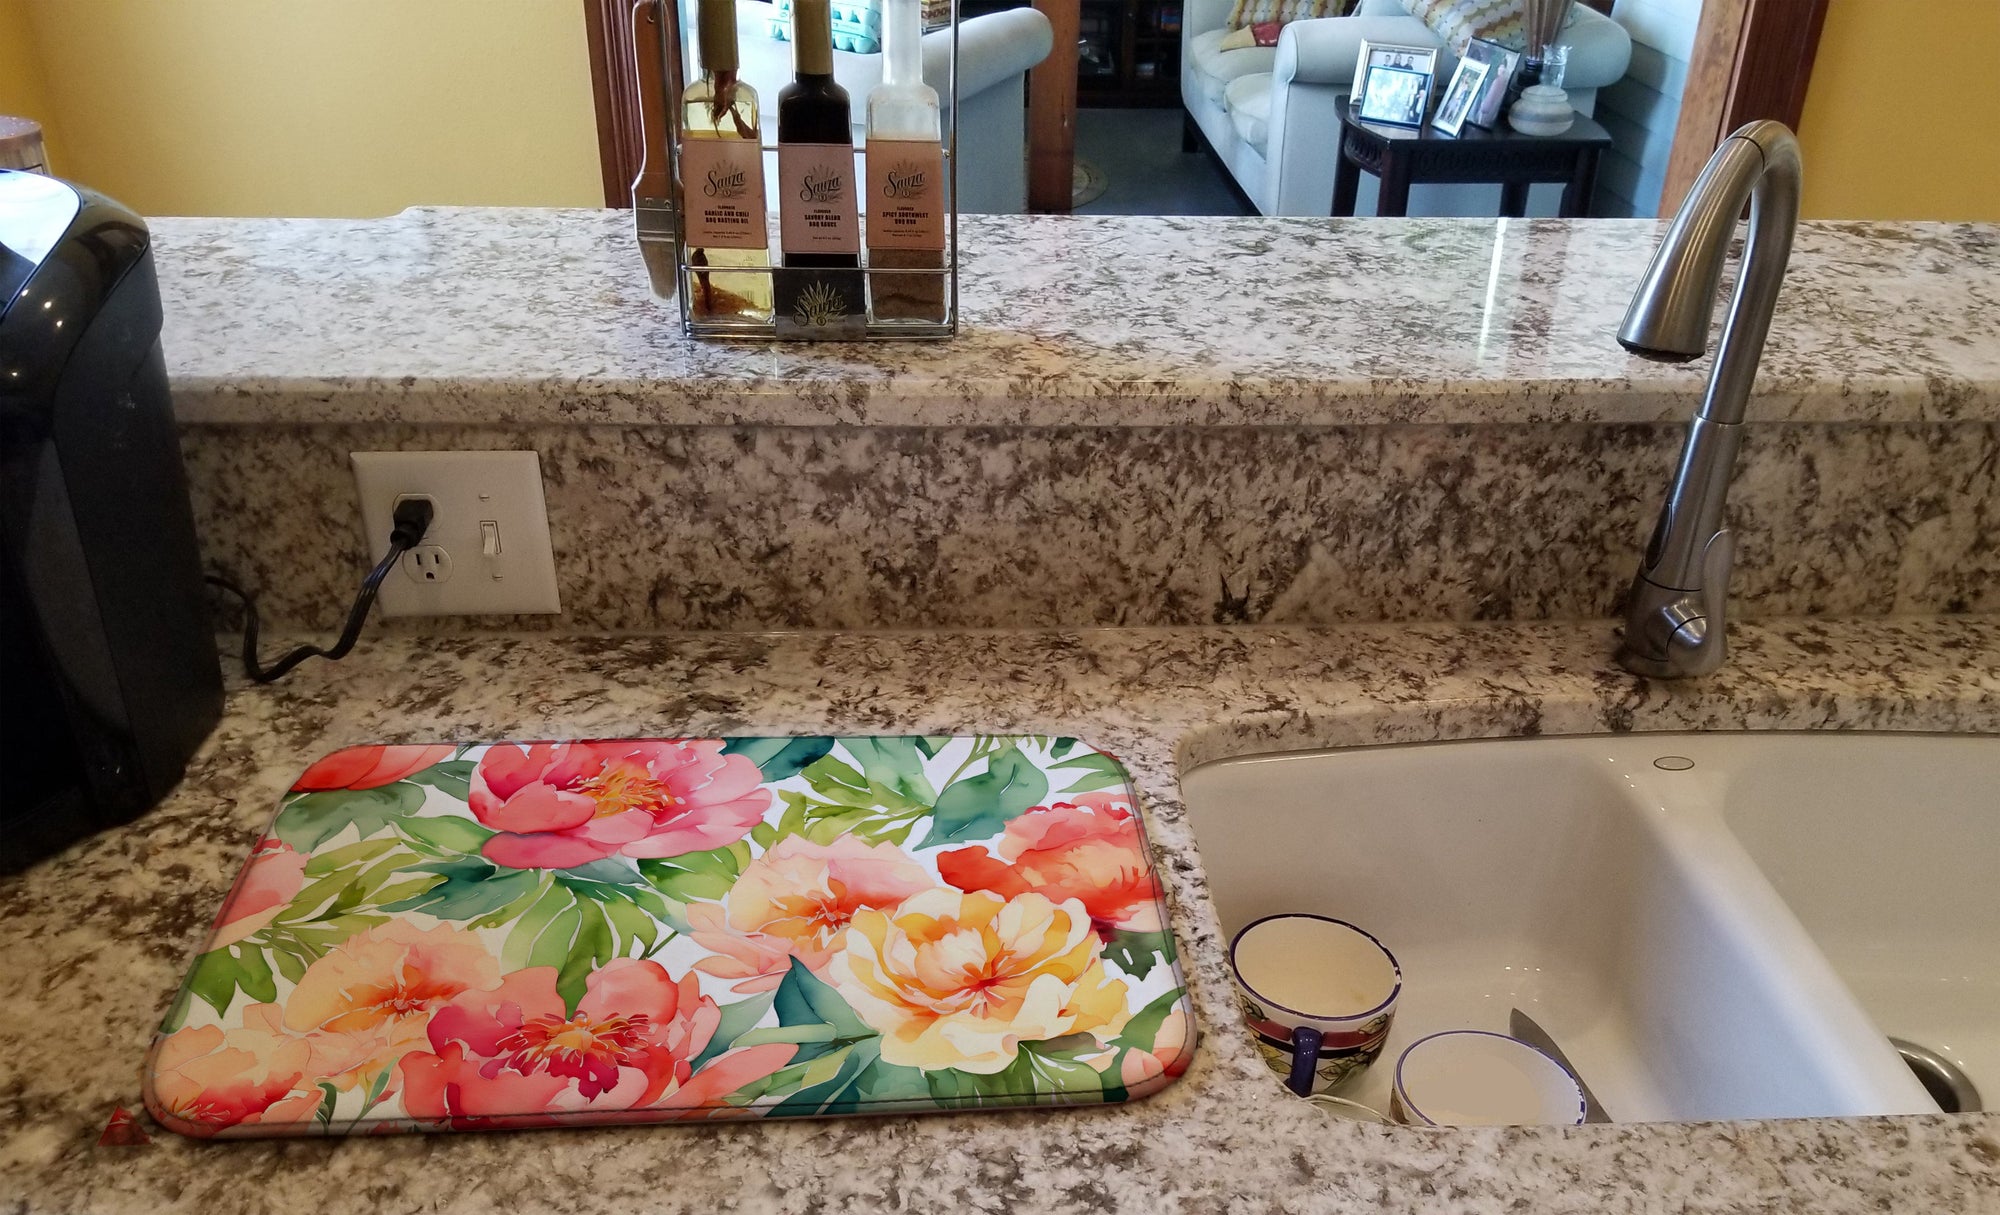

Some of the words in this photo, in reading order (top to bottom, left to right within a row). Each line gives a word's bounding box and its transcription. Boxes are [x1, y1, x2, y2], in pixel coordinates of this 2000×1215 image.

[704, 170, 745, 197] Sauza
[800, 175, 842, 202] Sauza
[884, 170, 925, 198] Sauza
